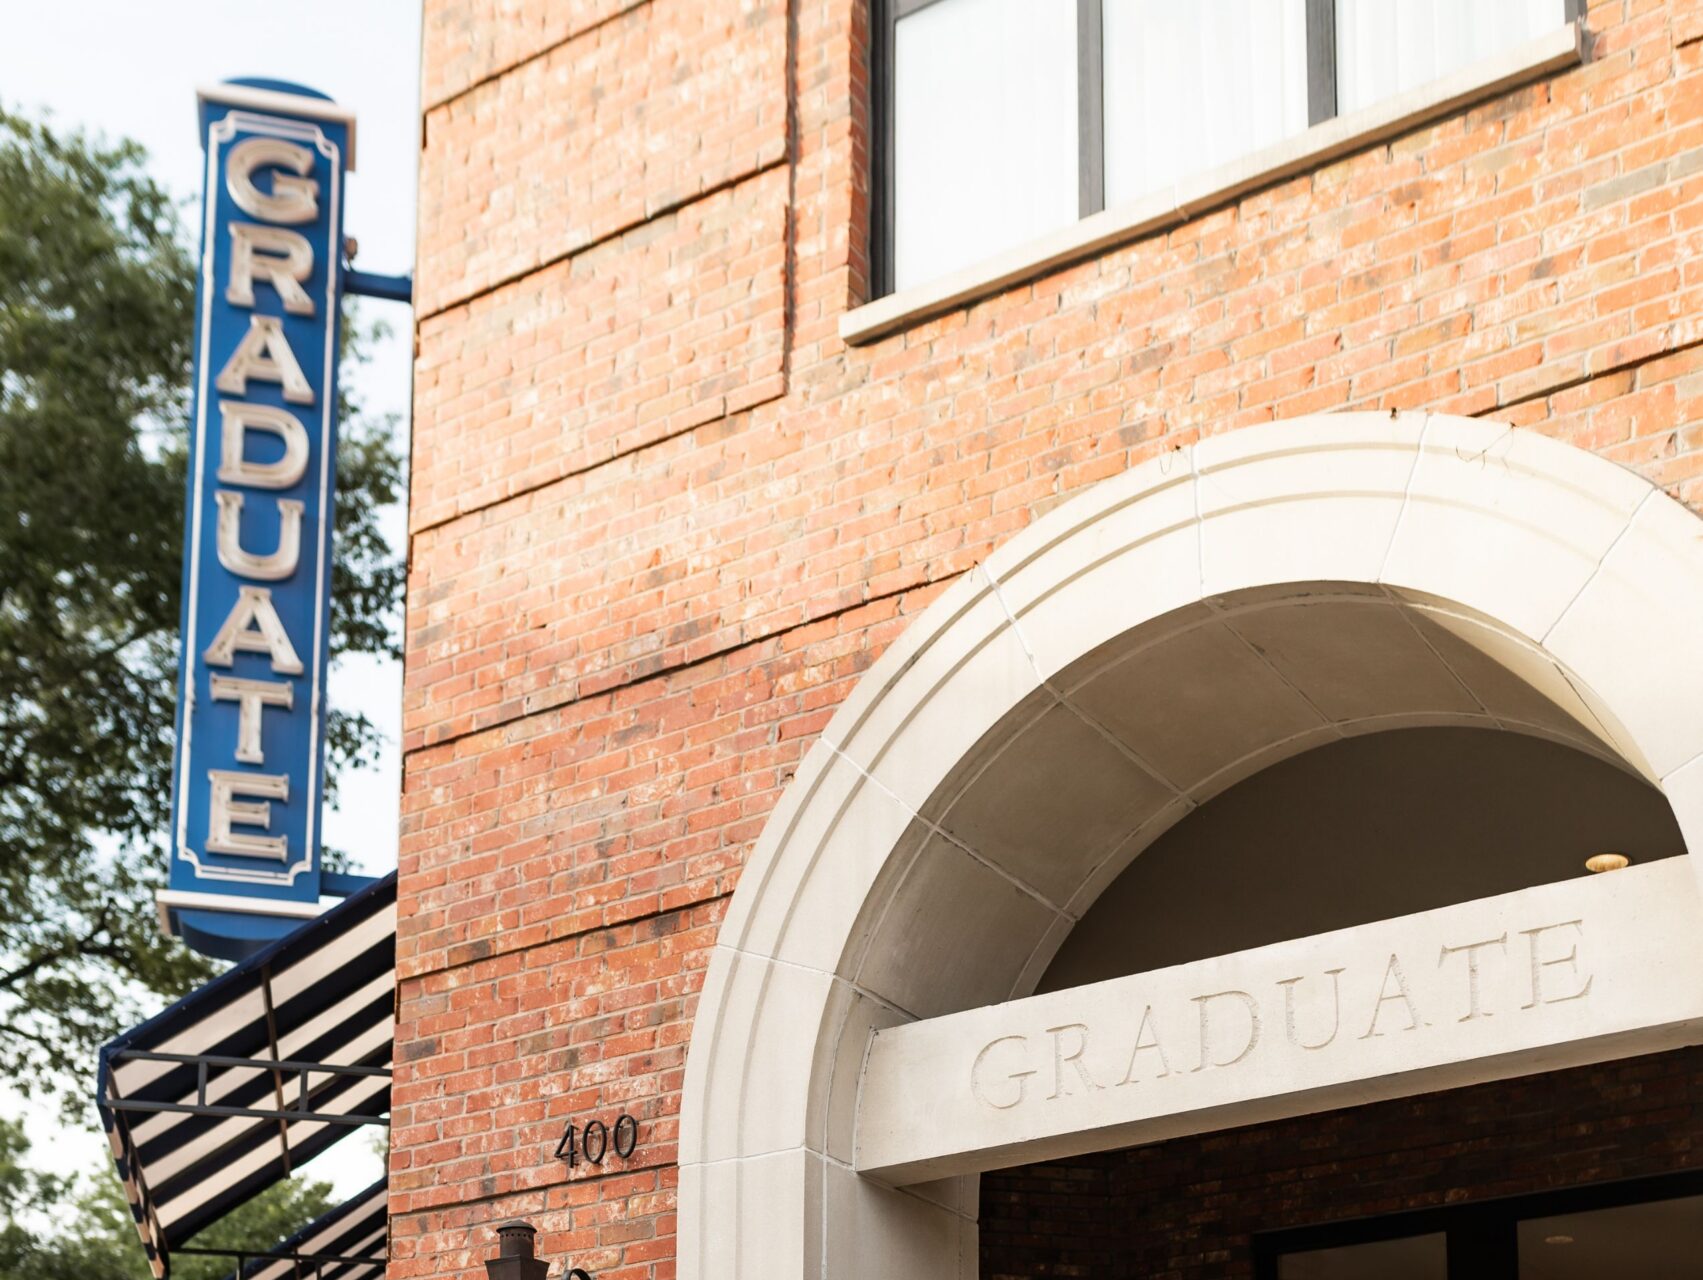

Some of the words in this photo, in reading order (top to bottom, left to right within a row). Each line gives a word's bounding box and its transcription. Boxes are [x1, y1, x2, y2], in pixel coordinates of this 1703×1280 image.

[204, 139, 320, 862] GRADUATE
[970, 919, 1594, 1110] GRADUATE
[554, 1114, 639, 1169] 400
